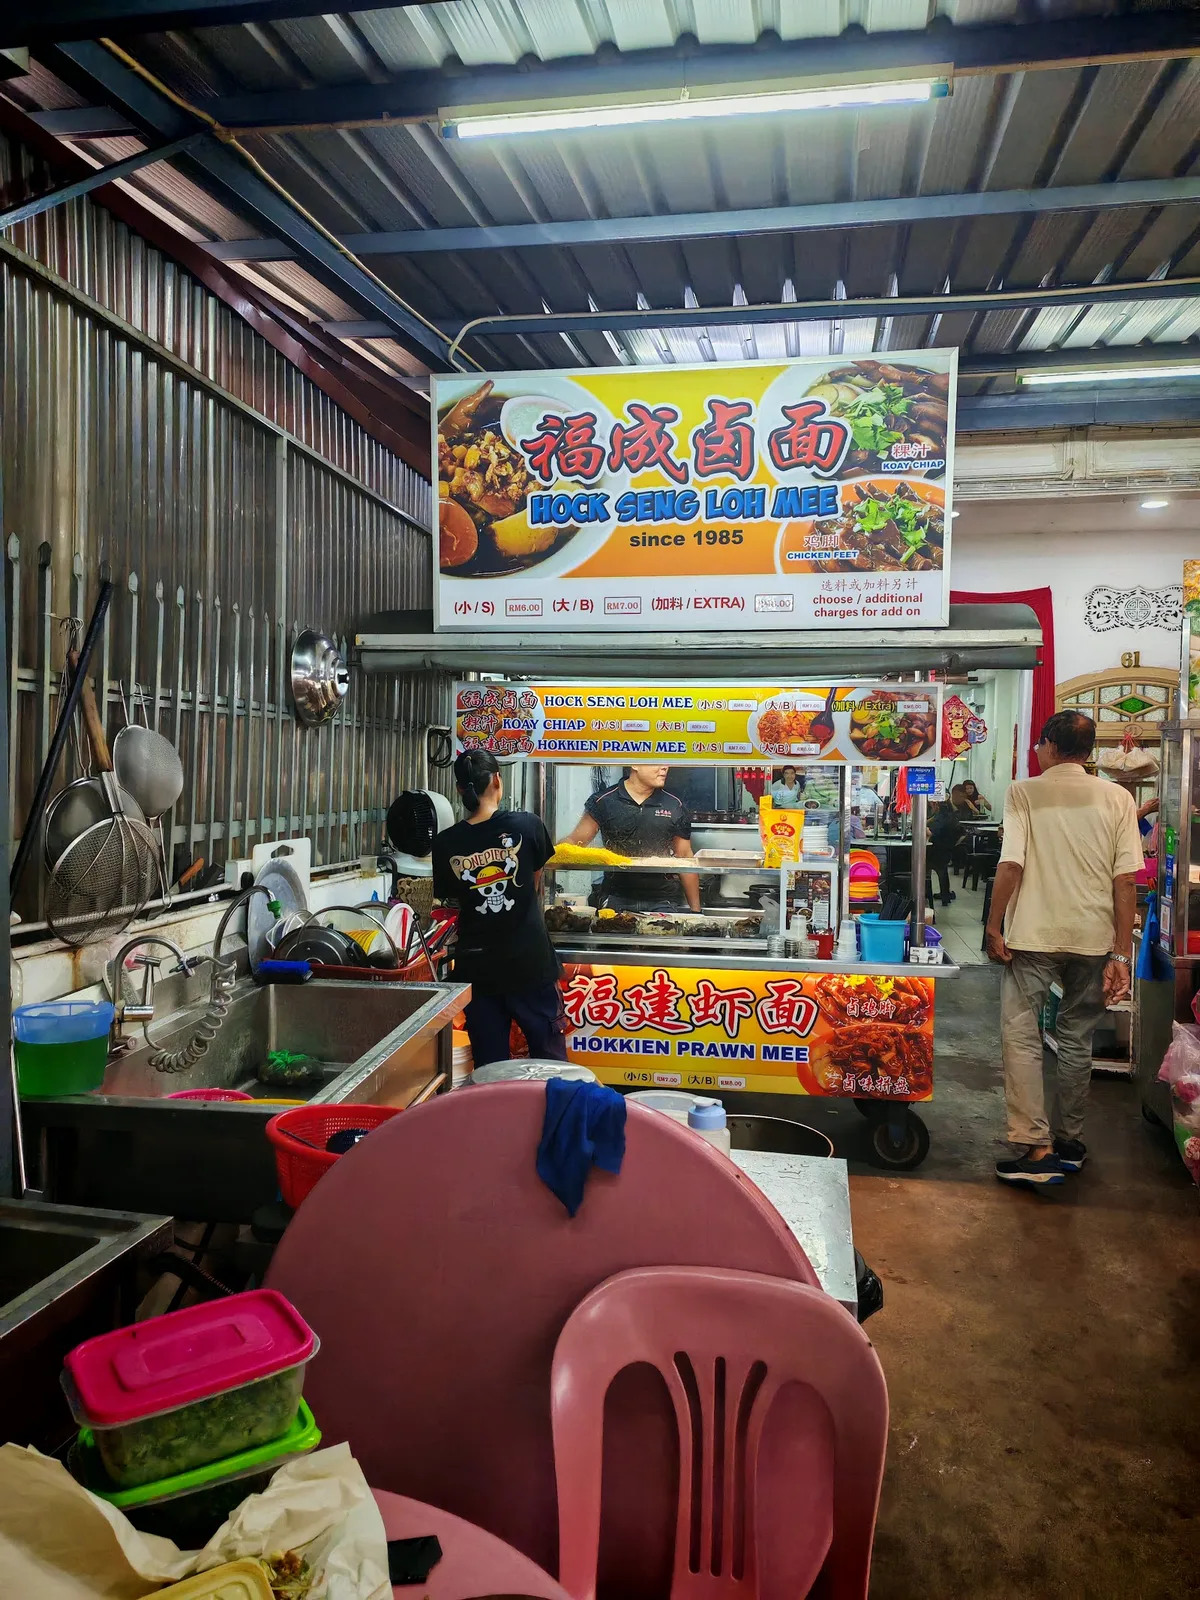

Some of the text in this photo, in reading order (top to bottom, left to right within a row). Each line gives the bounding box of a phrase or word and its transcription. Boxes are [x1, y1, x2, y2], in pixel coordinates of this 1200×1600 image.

[522, 399, 849, 484] 福成卤面
[892, 443, 930, 458] 粿汁
[883, 460, 944, 470] KOAY CHIAP
[531, 485, 839, 525] HOCK SENG LOH MEE
[630, 529, 744, 547] since 1985
[803, 535, 839, 548] 鸡脚
[787, 551, 858, 560] CHICKEN FEET
[821, 577, 918, 592] 选料或加料另计
[508, 603, 540, 612] RM6.00
[607, 601, 639, 610] RM7.00
[813, 594, 853, 604] choose
[865, 593, 923, 603] additional
[814, 606, 921, 618] charges for add on
[1121, 651, 1141, 668] 61
[462, 690, 538, 710] 福成卤面
[544, 696, 583, 707] HOCK
[588, 696, 625, 707] SENG
[630, 697, 658, 708] LOH
[662, 697, 693, 708] MEE
[462, 714, 498, 734] 粿汁
[503, 719, 539, 729] KOAY
[543, 720, 585, 730] CHIAP
[463, 735, 534, 754] 福建虾面
[538, 740, 598, 751] HOKKIEN
[602, 741, 651, 752] PRAWN
[656, 742, 686, 752] MEE
[563, 969, 819, 1038] 福建虾面
[847, 997, 896, 1019] 卤鸡脚
[572, 1036, 809, 1062] HOKKIEN PRAWN MEE
[842, 1073, 910, 1095] 卤味拼盘
